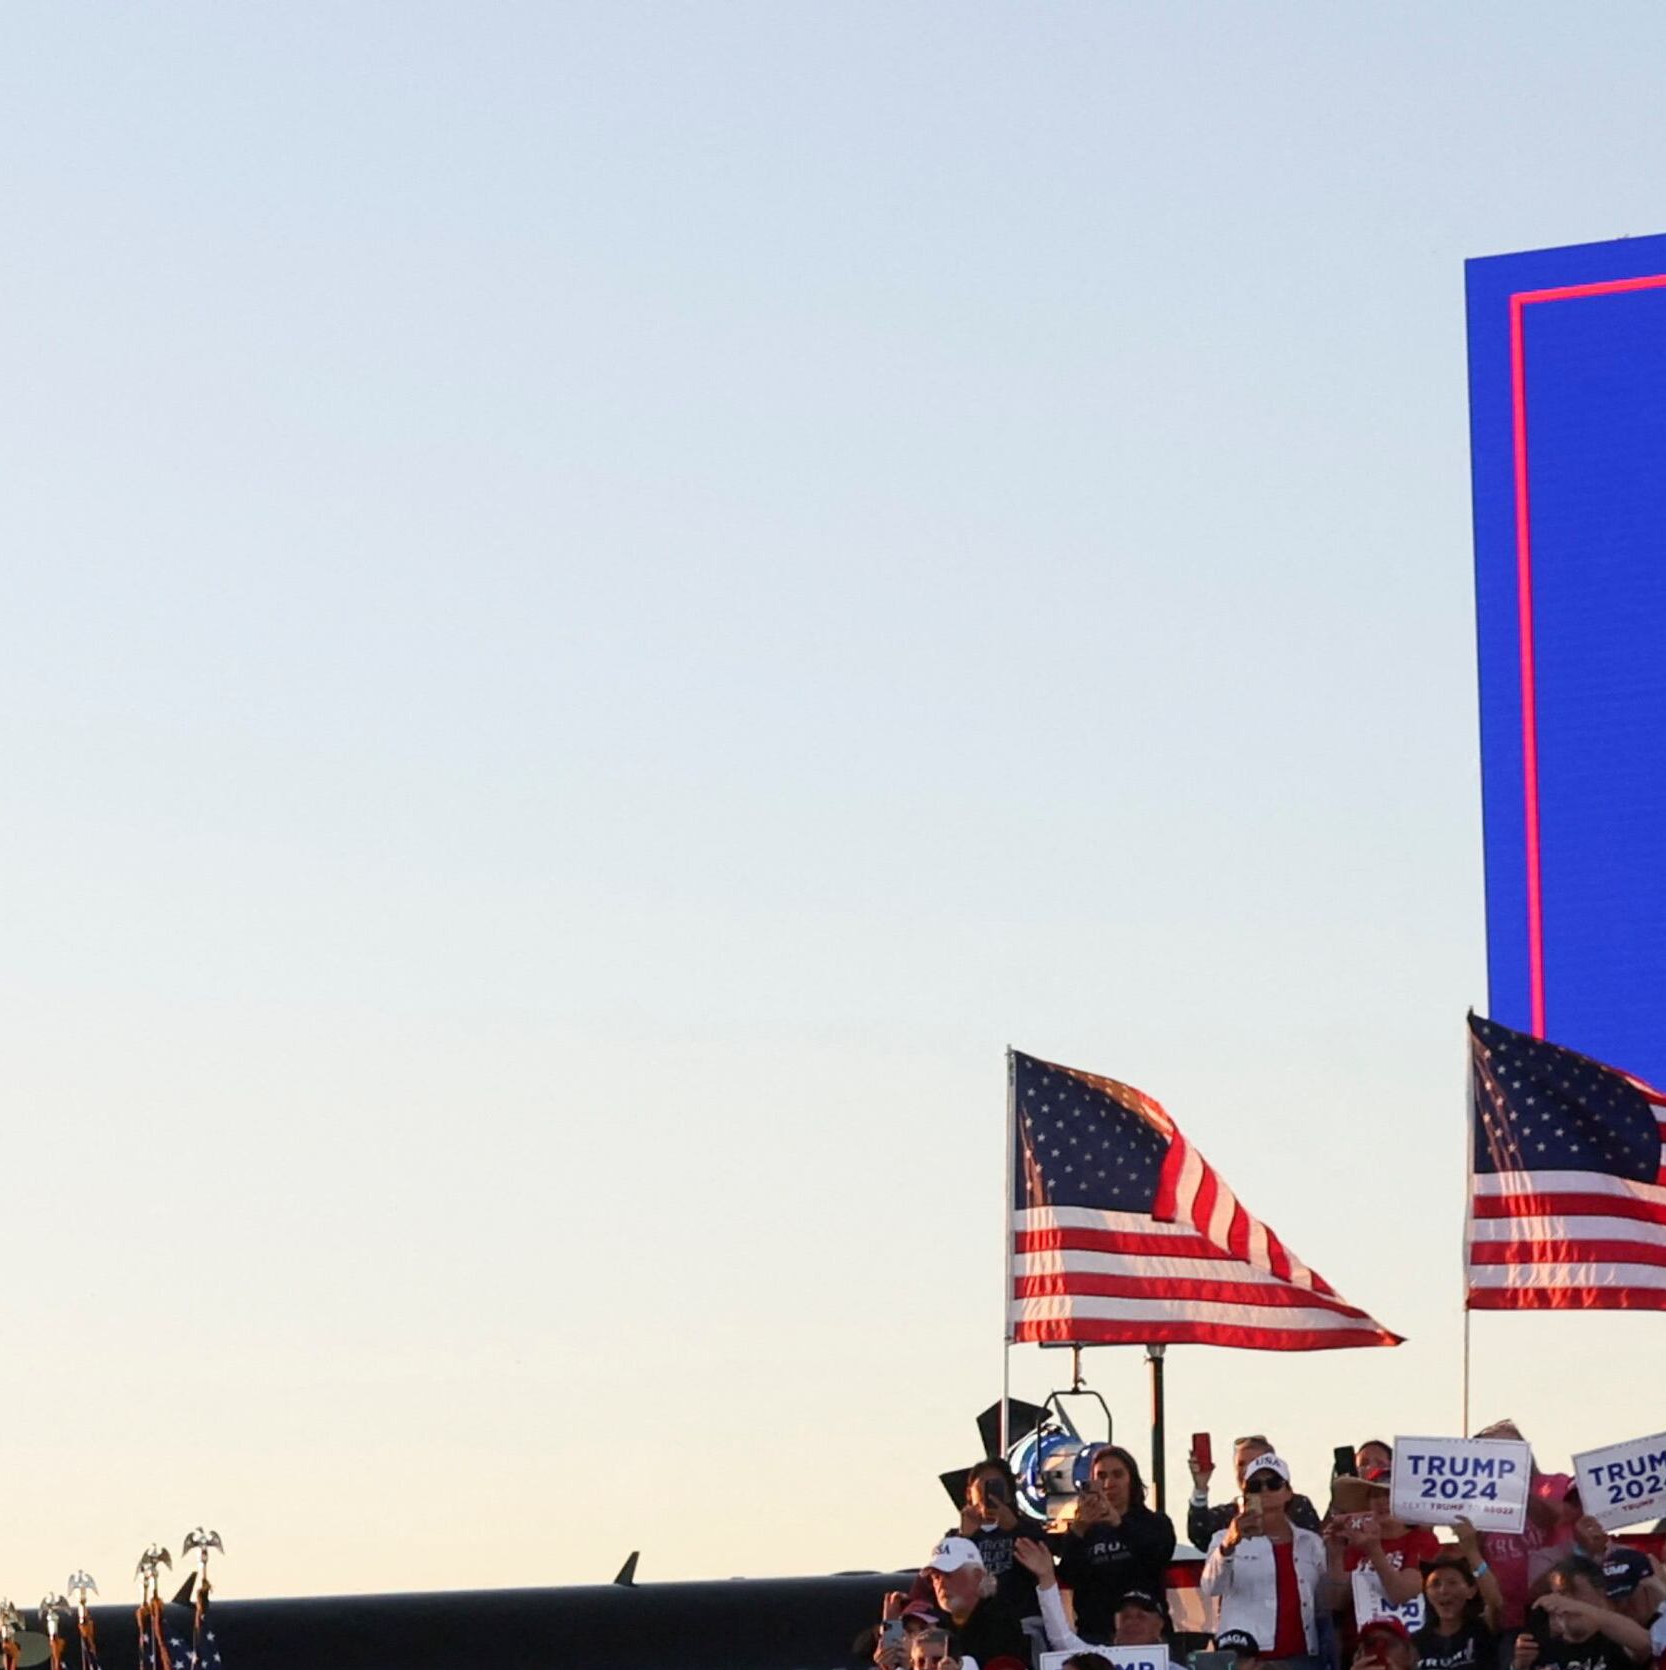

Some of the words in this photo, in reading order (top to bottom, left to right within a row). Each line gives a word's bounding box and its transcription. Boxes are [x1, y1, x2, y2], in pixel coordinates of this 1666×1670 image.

[1407, 1455, 1516, 1479] TRUMP
[1420, 1478, 1498, 1501] 2024
[1218, 1632, 1248, 1646] MAGA
